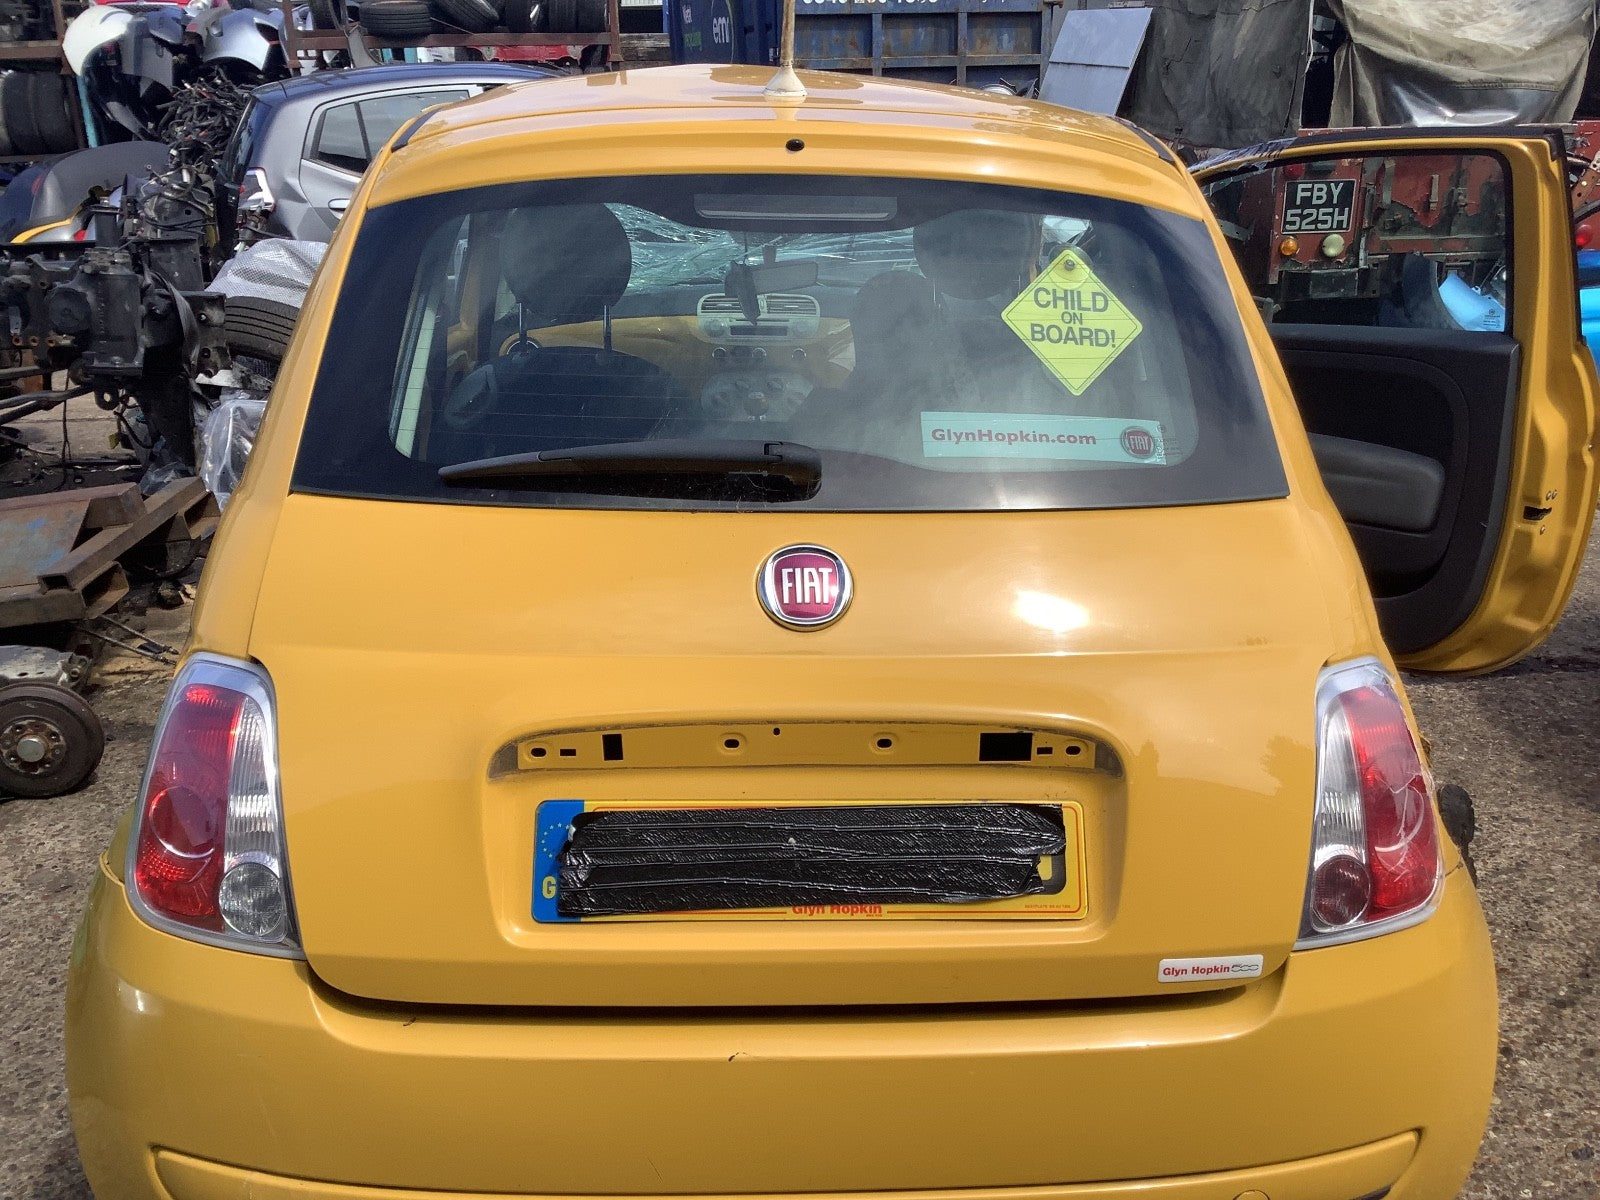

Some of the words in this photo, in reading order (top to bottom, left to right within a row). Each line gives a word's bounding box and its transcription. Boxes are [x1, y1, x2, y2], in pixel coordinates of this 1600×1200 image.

[1295, 183, 1343, 205] FBY
[1285, 207, 1349, 230] 525H
[1033, 287, 1109, 312] CHILD
[1061, 311, 1083, 325] ON
[1030, 323, 1116, 348] BOARD!
[931, 428, 1097, 445] GlynHopkin.com
[1129, 436, 1149, 450] FIAT
[781, 567, 833, 604] FIAT
[829, 905, 883, 916] Hopkin
[1162, 967, 1188, 977] Glyn
[1191, 965, 1230, 976] Hopkin
